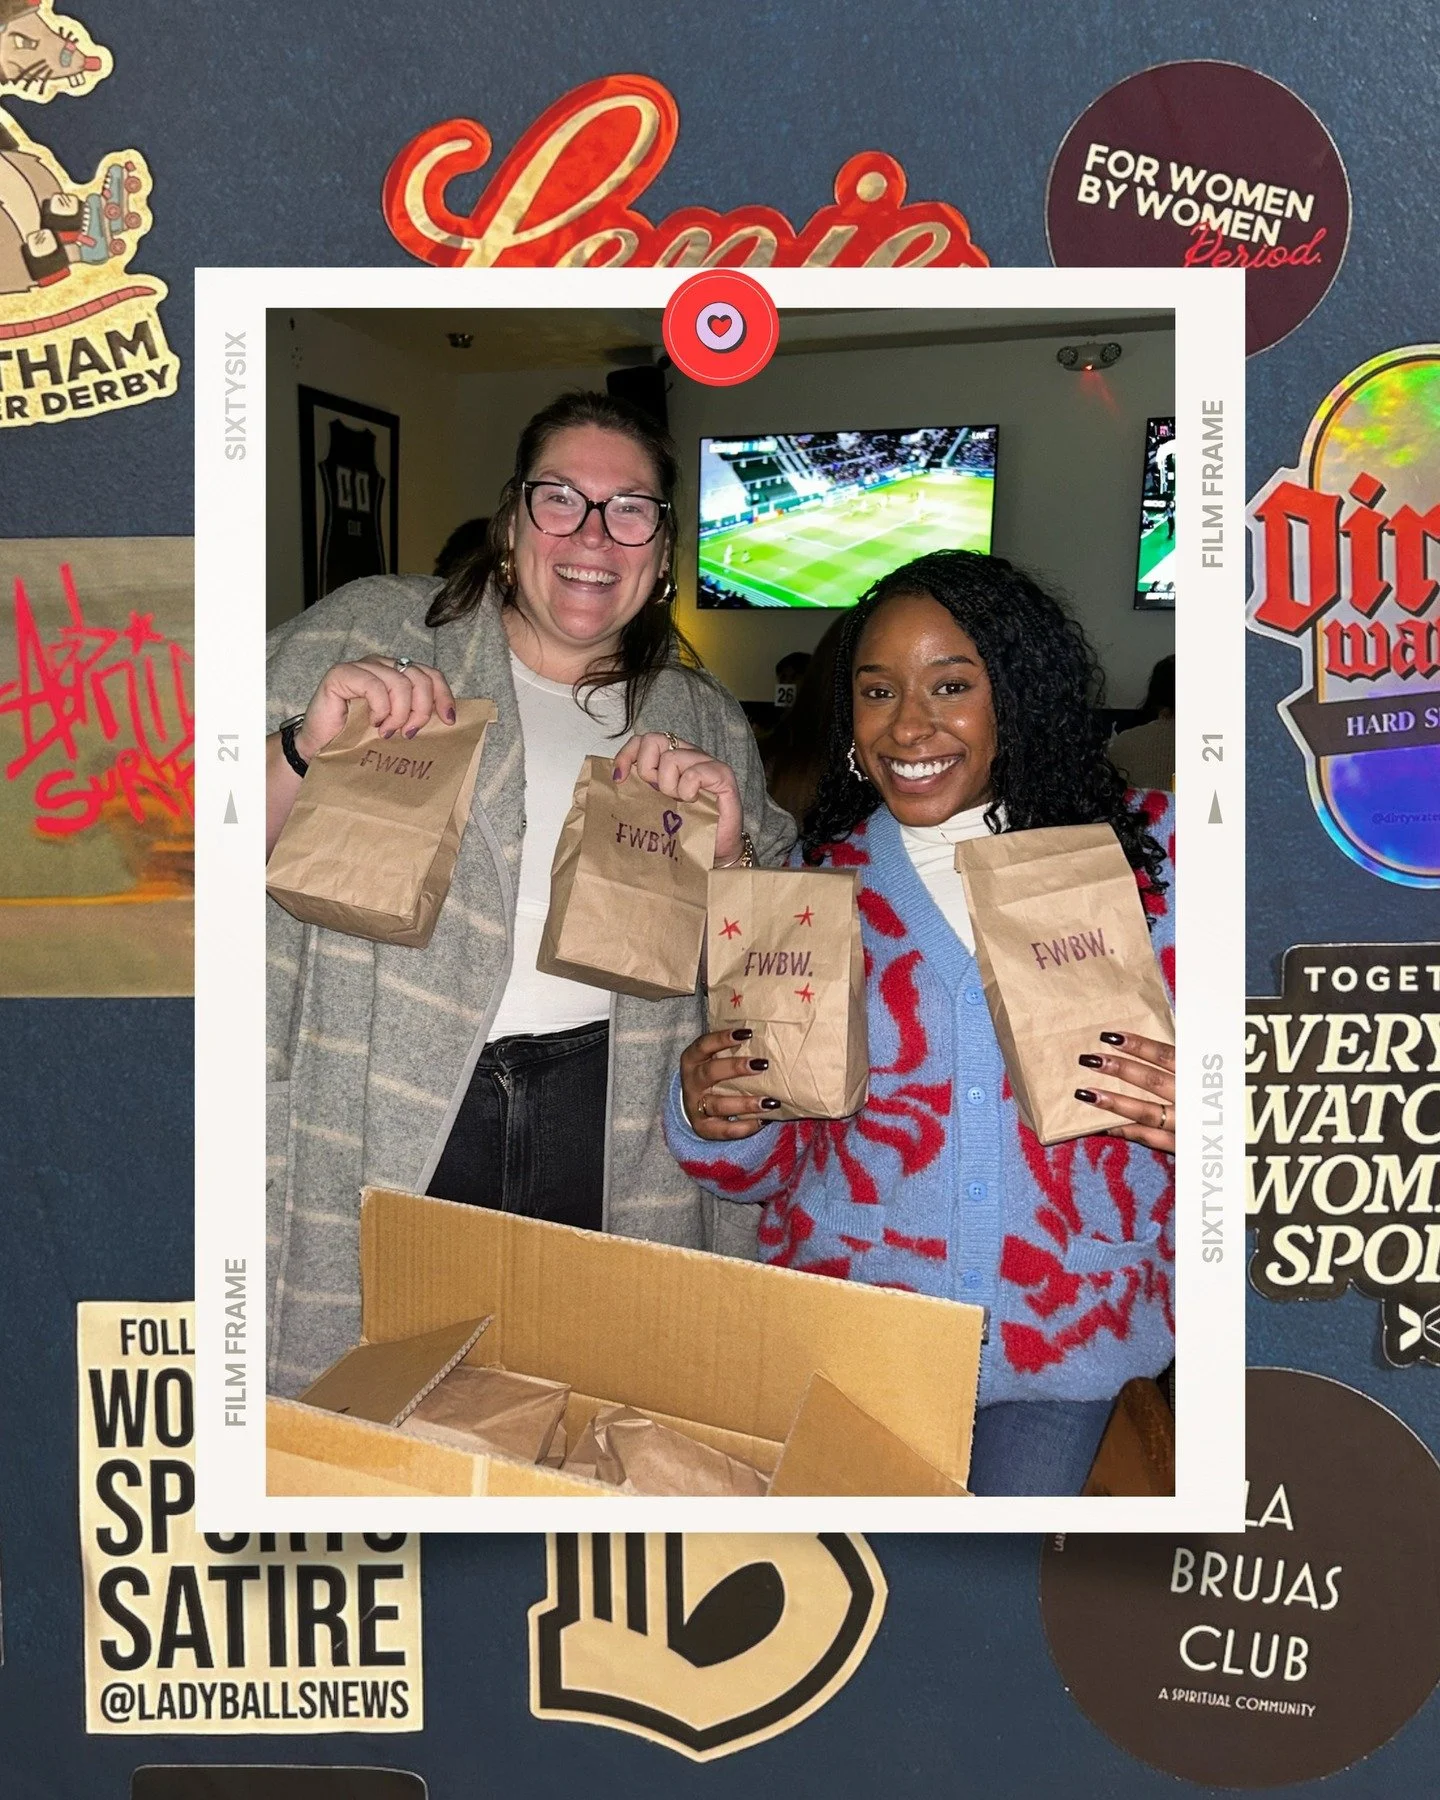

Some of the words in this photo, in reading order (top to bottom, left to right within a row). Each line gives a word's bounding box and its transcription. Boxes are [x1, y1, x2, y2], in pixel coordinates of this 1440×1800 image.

[1085, 143, 1160, 187] FOR
[1170, 161, 1314, 223] WOMEN
[1077, 173, 1128, 209] BY
[1136, 186, 1281, 247] WOMEN
[1183, 222, 1327, 268] Period.
[41, 364, 170, 415] DERBY
[1323, 618, 1440, 681] wa
[777, 687, 794, 704] 26
[1346, 710, 1416, 737] HARD
[1424, 708, 1440, 729] S
[360, 749, 434, 780] FWBW.
[615, 822, 679, 862] FWBW.
[743, 951, 813, 977] FWBW.
[1030, 927, 1115, 970] FWBW.
[1245, 1154, 1440, 1216] WOM
[120, 1318, 195, 1356] FOLL
[1170, 1547, 1343, 1612] BRUJAS
[99, 1564, 406, 1672] SATIRE
[1179, 1624, 1310, 1682] CLUB
[100, 1680, 410, 1725] @LADYBALLSNEWS
[1158, 1687, 1169, 1700] A
[1172, 1688, 1232, 1708] SPIRITUAL
[1235, 1696, 1317, 1717] COMMUNITY
